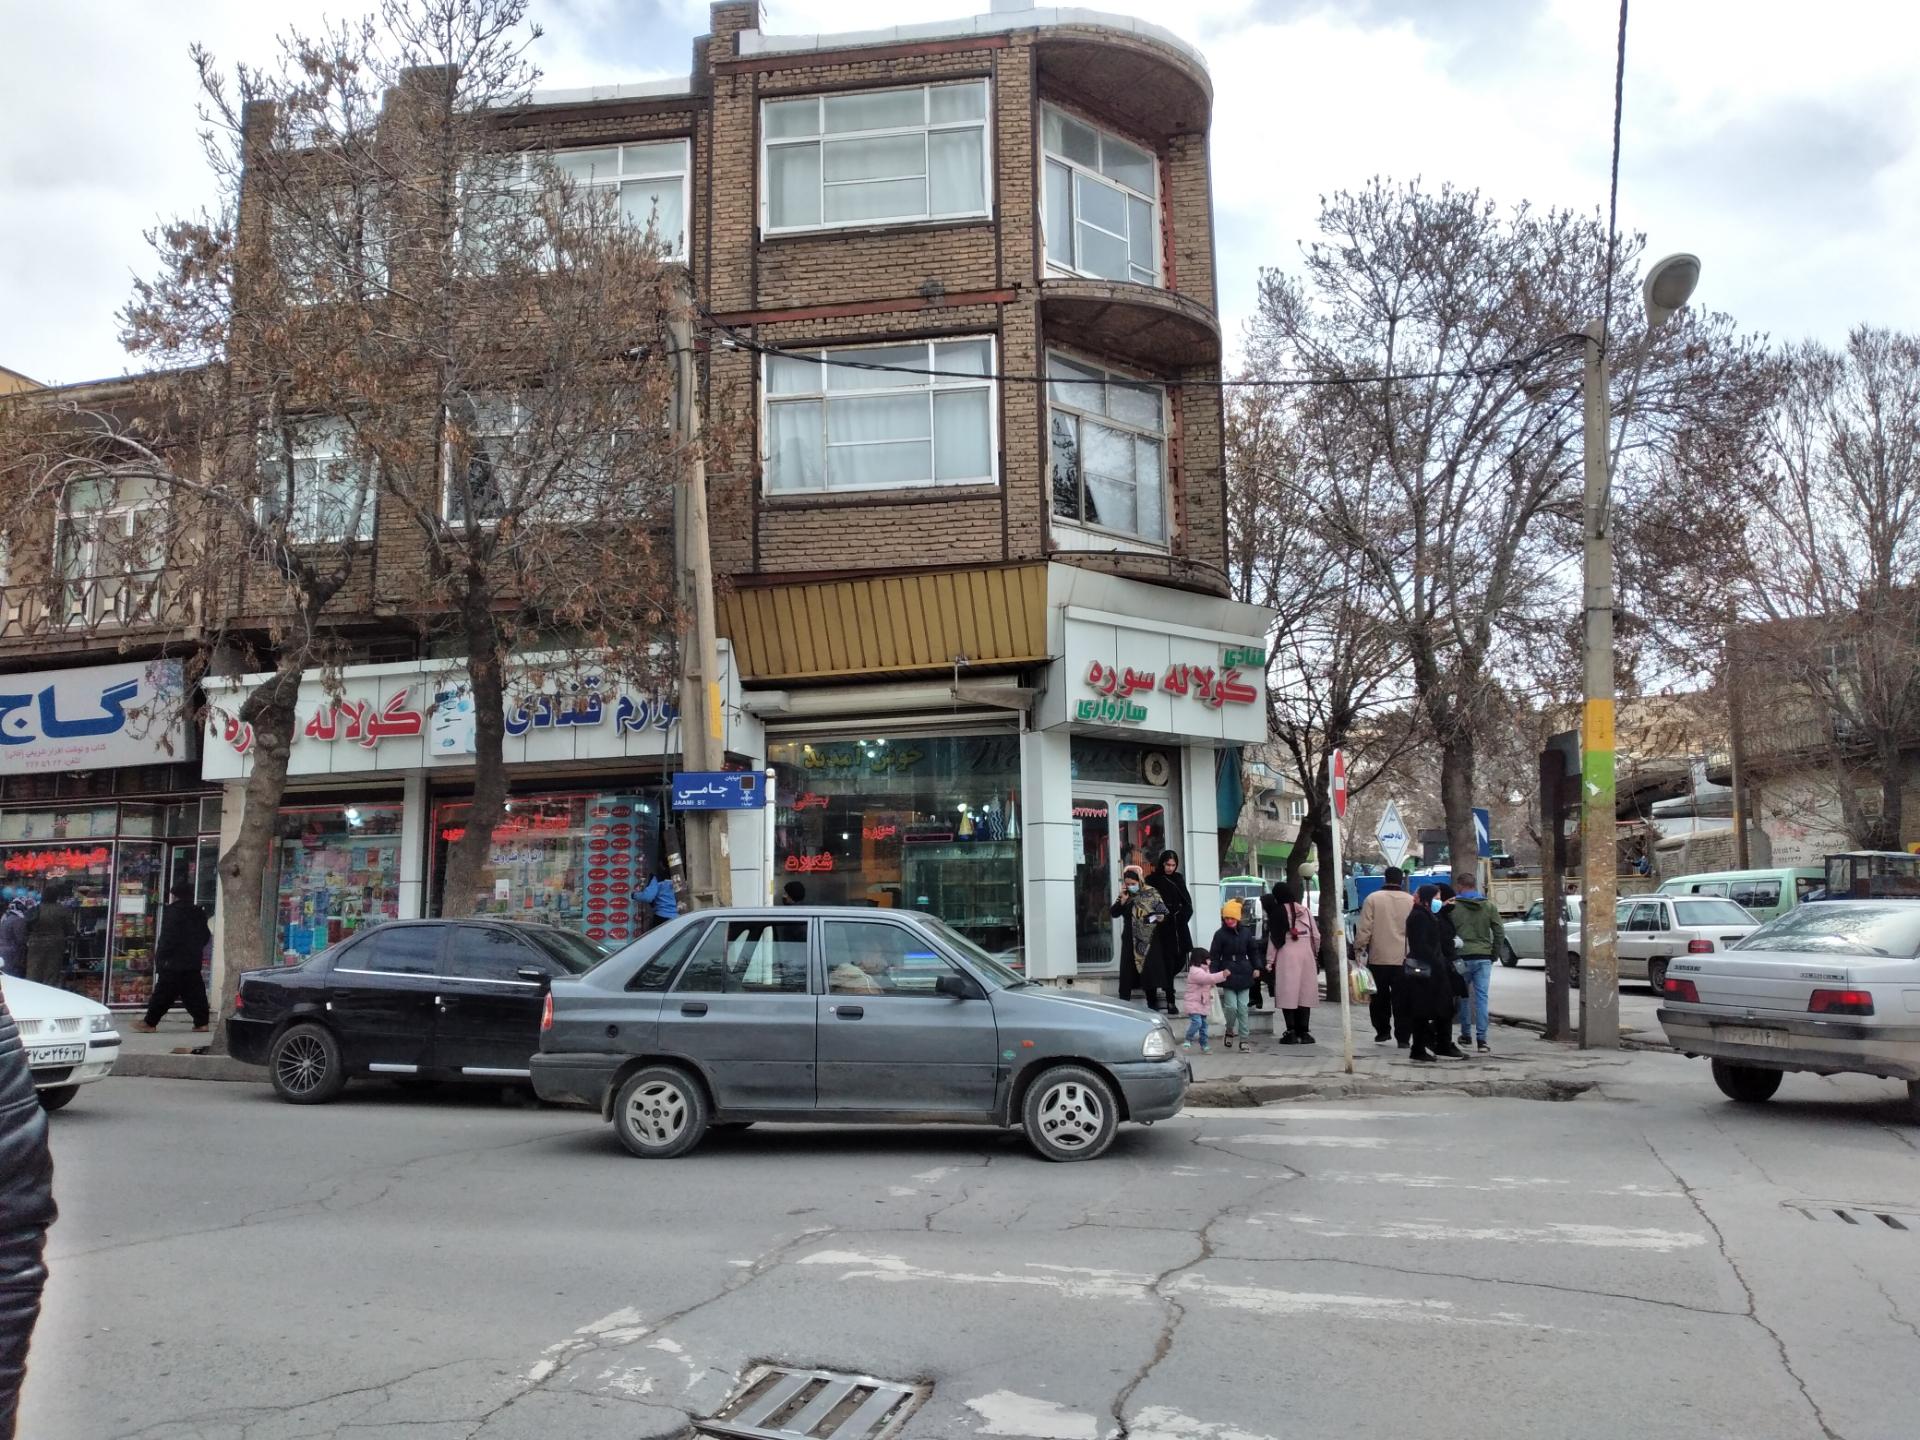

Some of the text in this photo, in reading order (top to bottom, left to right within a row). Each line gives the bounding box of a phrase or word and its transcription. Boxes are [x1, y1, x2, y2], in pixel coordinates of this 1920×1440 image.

[1086, 660, 1155, 697] سوره
[0, 678, 138, 745] گاج
[304, 687, 423, 748] گولاله
[616, 690, 682, 737] وازم
[678, 782, 728, 798] جامی
